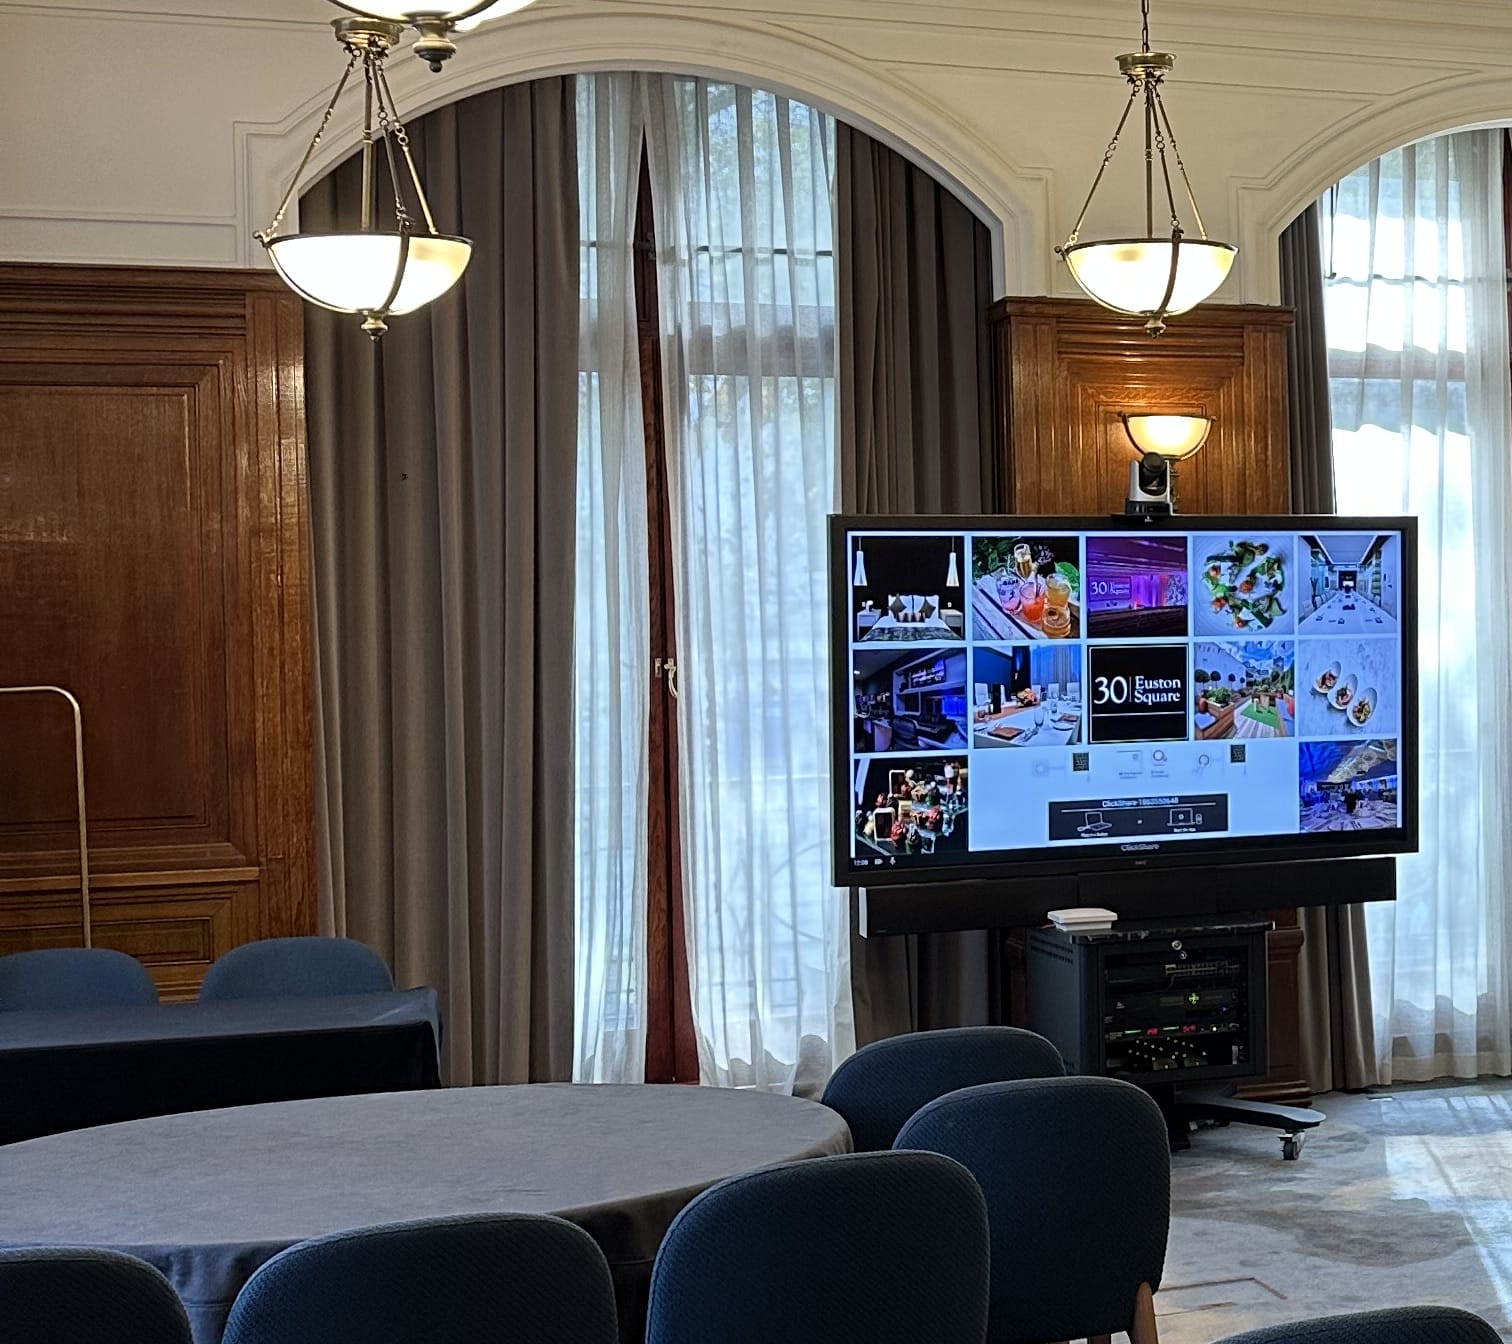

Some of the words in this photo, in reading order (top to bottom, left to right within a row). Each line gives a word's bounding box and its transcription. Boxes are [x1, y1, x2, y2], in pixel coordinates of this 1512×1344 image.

[1091, 582, 1107, 595] 30
[1135, 675, 1181, 689] Euston
[1093, 676, 1127, 704] 30
[1134, 690, 1181, 705] Square
